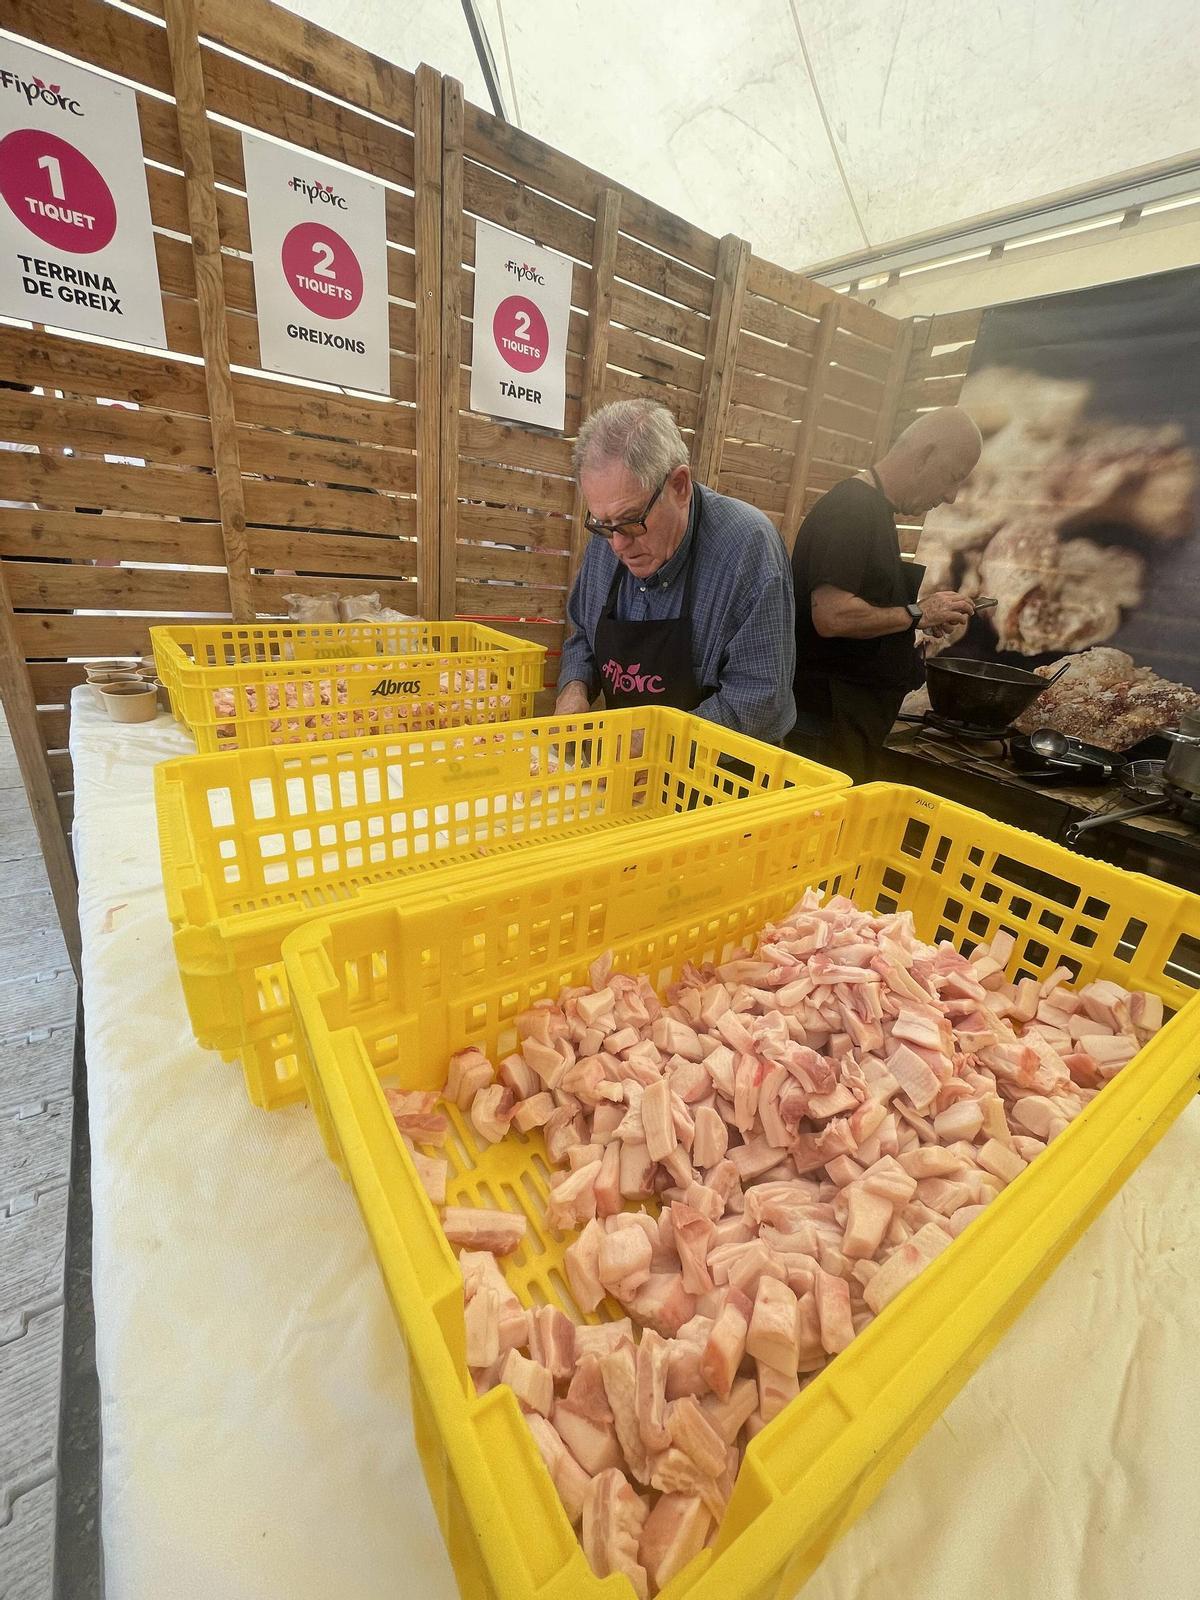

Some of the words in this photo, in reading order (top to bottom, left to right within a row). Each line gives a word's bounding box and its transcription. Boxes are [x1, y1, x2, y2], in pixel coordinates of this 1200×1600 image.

[38, 155, 65, 201] 1
[25, 197, 96, 231] TIQUET
[17, 254, 118, 295] TERRINA
[311, 242, 337, 279] 2
[22, 276, 54, 299] DE
[58, 287, 124, 316] GREIX
[296, 274, 353, 301] TIQUETS
[286, 324, 366, 355] GREIXONS
[514, 311, 531, 341] 2
[501, 338, 541, 358] TIQUETS
[499, 380, 542, 405] TÀPER
[371, 679, 421, 697] Abras
